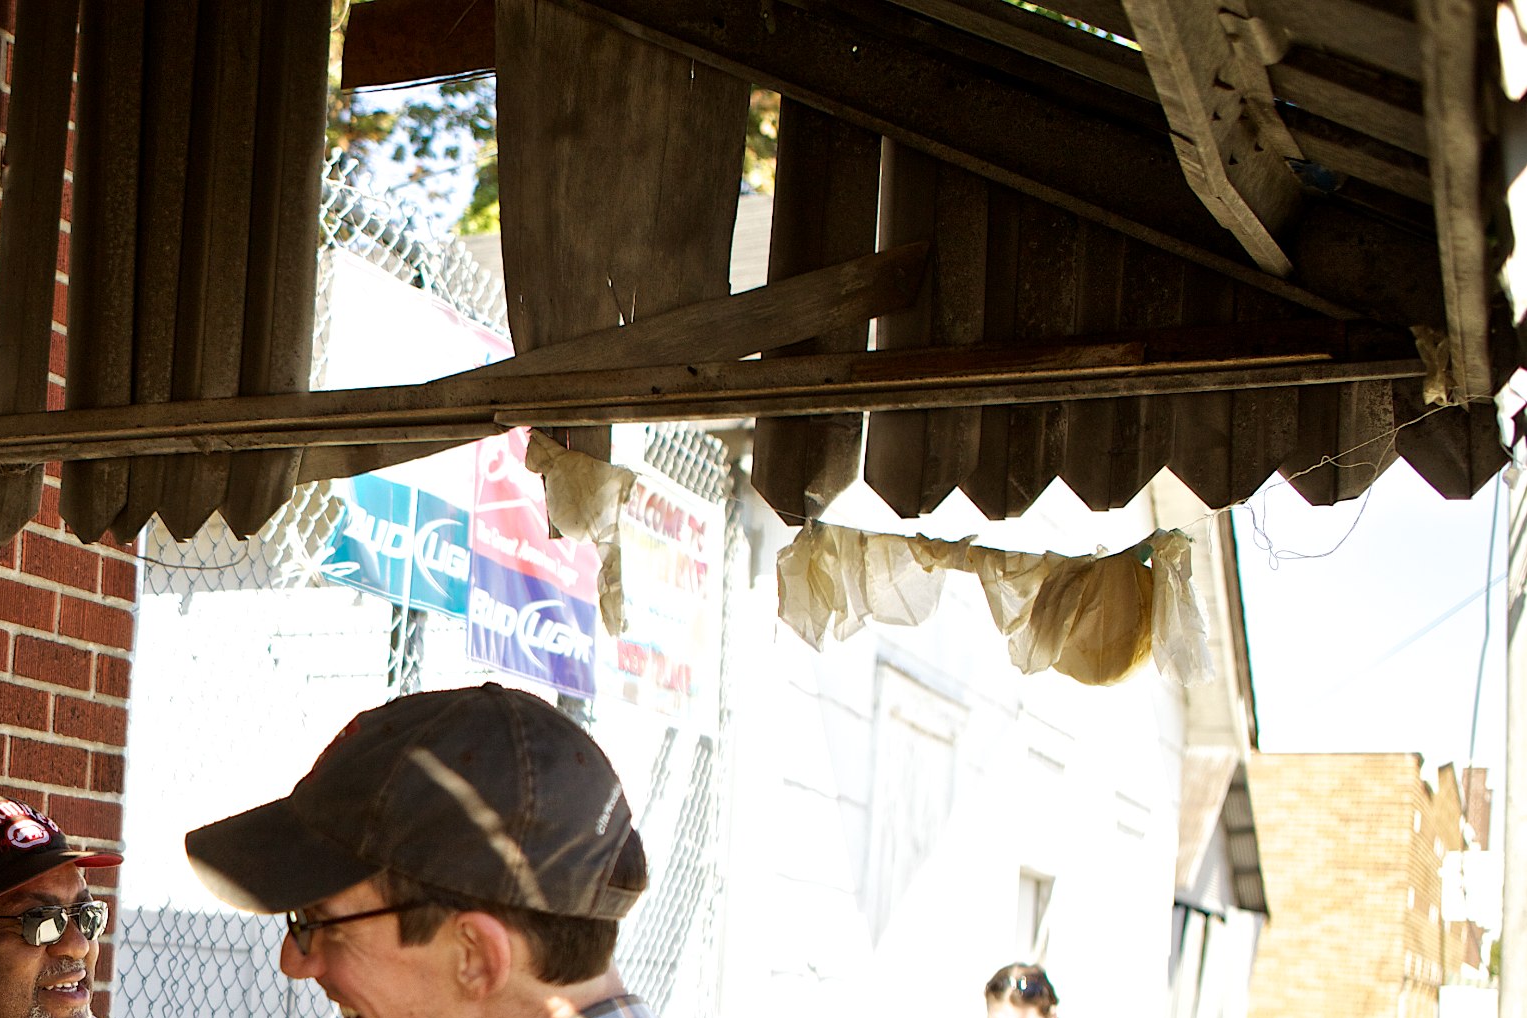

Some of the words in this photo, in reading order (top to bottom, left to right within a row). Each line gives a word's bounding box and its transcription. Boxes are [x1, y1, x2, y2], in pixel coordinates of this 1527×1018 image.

[345, 500, 412, 560] BUD
[472, 587, 518, 638] BUD
[524, 612, 594, 663] LIGHT
